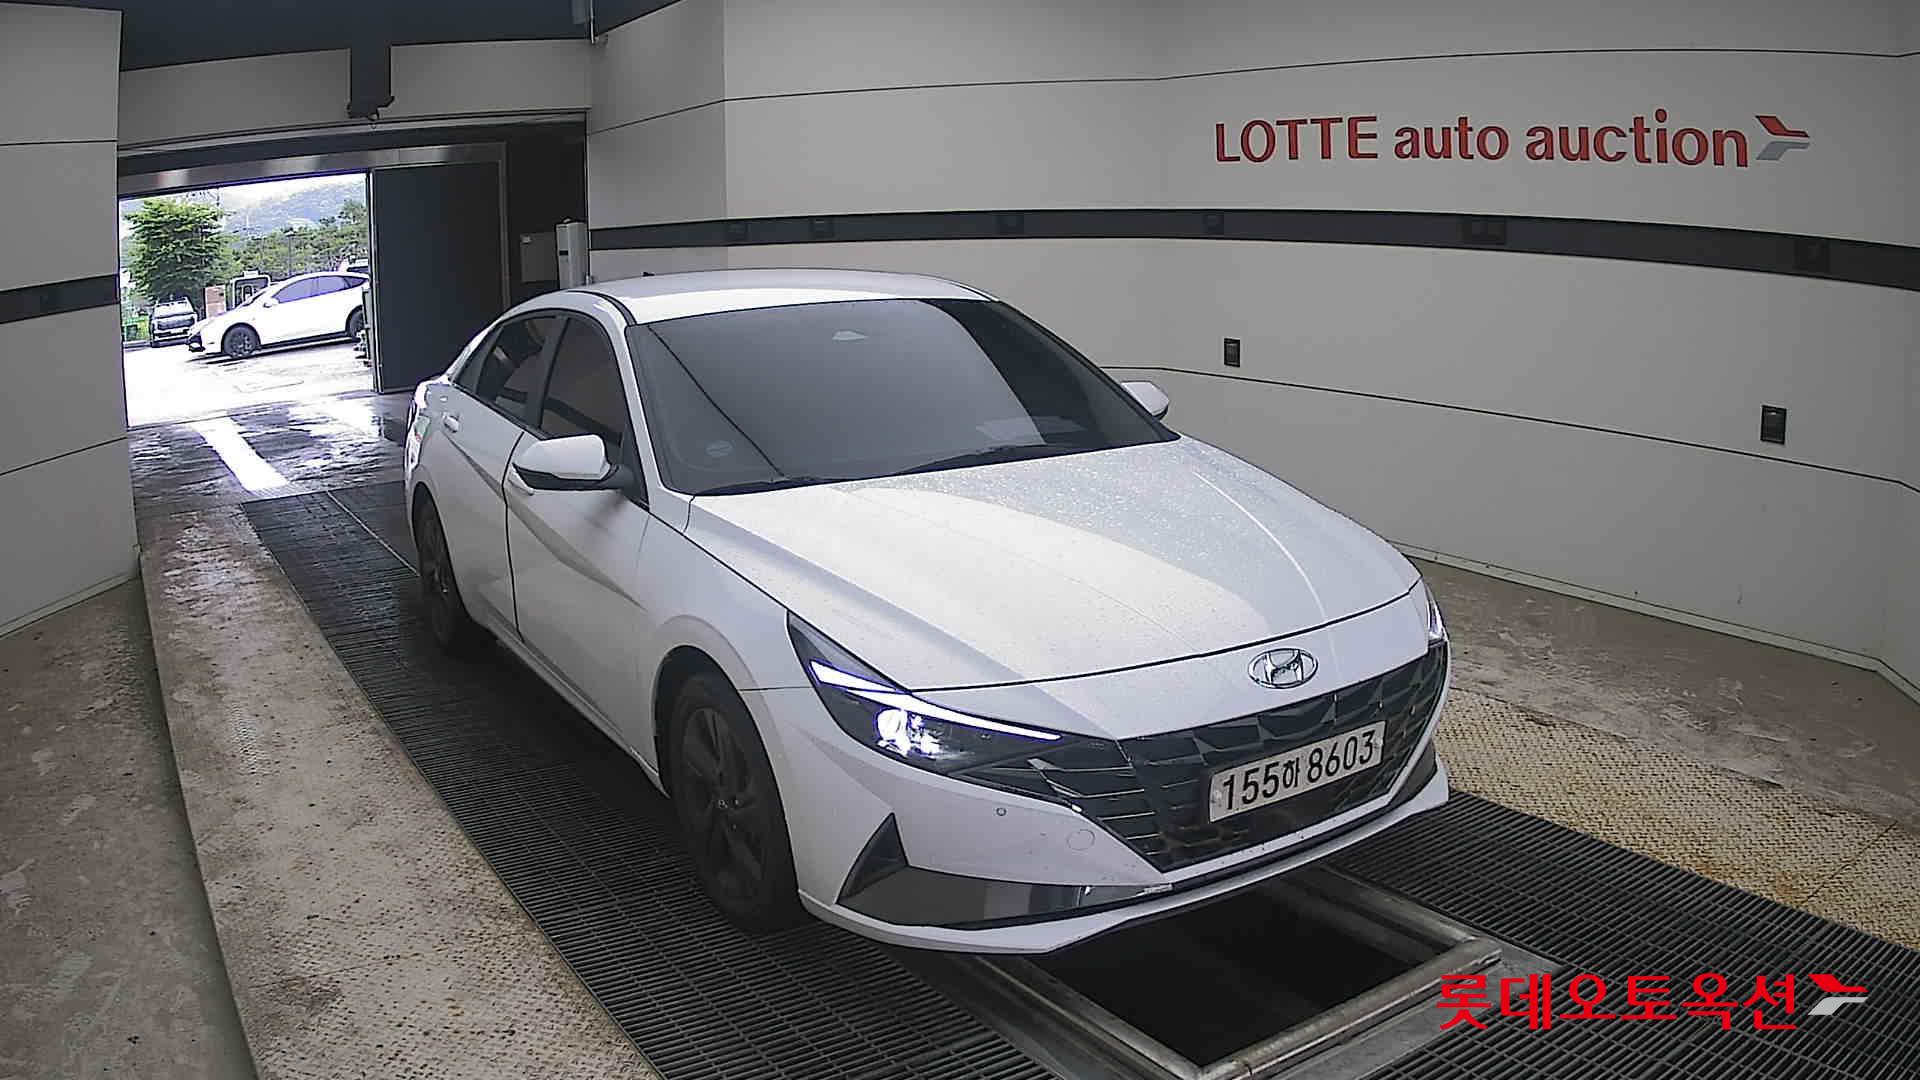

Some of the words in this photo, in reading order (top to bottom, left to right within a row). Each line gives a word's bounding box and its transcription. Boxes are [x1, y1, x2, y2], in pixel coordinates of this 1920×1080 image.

[1216, 116, 1378, 163] LOTTE
[1394, 116, 1509, 161] auto
[1525, 108, 1748, 168] auction
[1223, 757, 1300, 810] 155하
[1307, 730, 1376, 784] 8603
